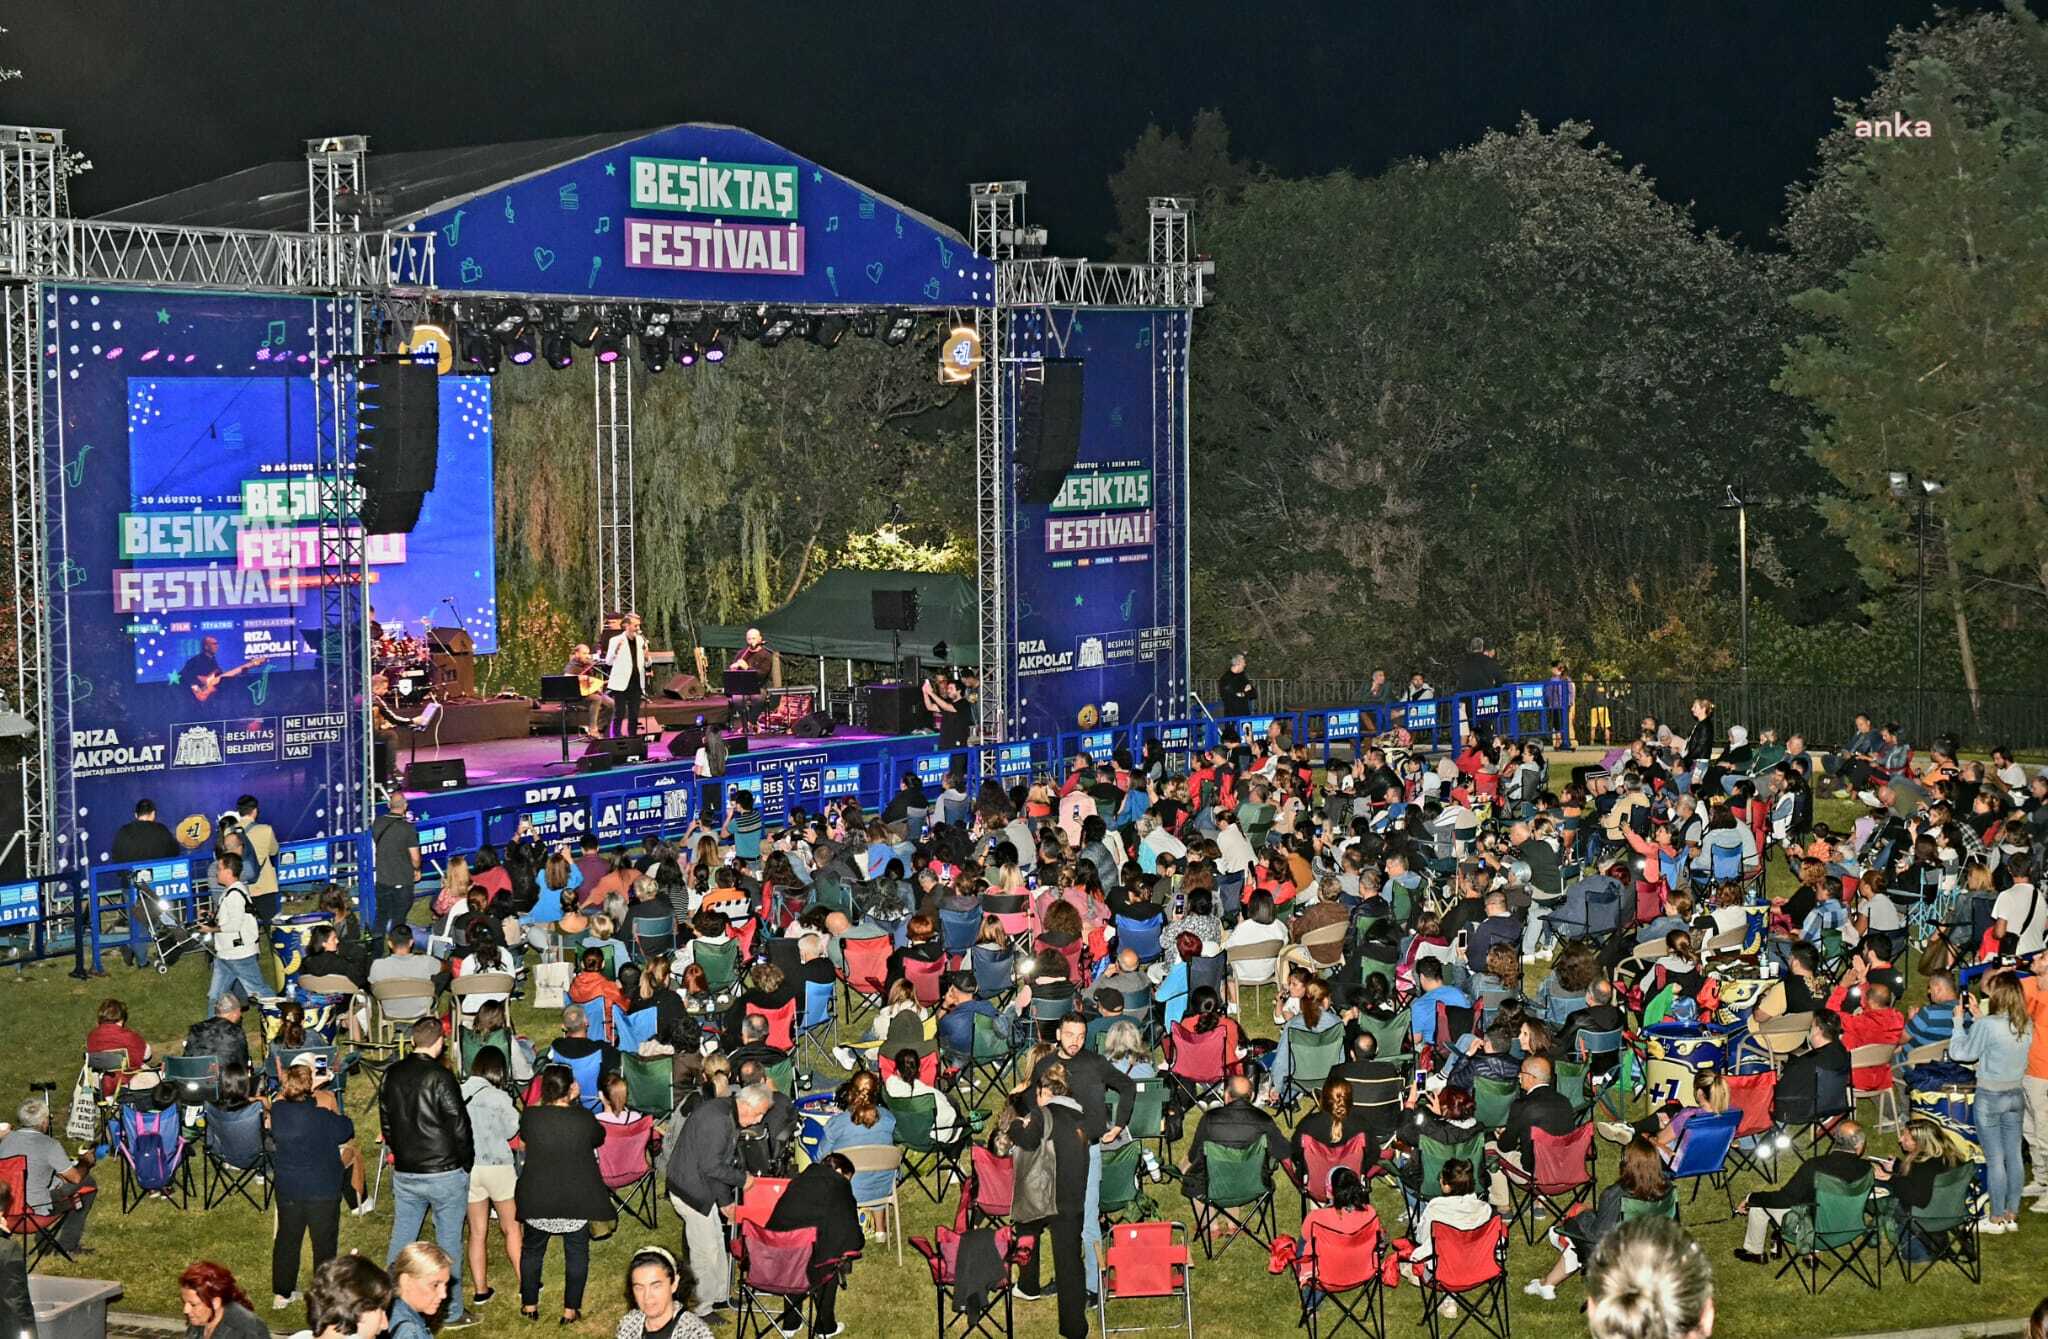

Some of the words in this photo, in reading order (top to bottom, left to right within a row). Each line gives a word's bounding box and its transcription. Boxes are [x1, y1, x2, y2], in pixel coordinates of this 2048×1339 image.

[634, 157, 794, 217] BEŞİKTAŞ
[631, 218, 798, 271] FESTİVALİ
[1049, 510, 1150, 550] FESTİVALİ
[1019, 639, 1046, 654] RIZA
[1019, 652, 1073, 669] AKPOLAT
[1476, 705, 1499, 716] ZABITA
[286, 718, 302, 728] NE
[307, 715, 345, 727] MUTLU
[1408, 716, 1436, 728] ZABITA
[73, 728, 119, 748] RIZA
[227, 729, 274, 742] BEŞİKTAŞ
[286, 730, 338, 743] BEŞİKTAŞ
[1328, 725, 1359, 737] ZABITA
[227, 741, 274, 755] BELEDİYESİ
[286, 745, 309, 757] VAR
[1162, 738, 1188, 750] ZABITA
[74, 745, 164, 769] AKPOLAT
[1001, 760, 1032, 773] ZABITA
[824, 783, 859, 794] ZABITA
[626, 808, 662, 822] ZABITA
[186, 822, 200, 838] +1
[278, 862, 328, 881] ZABITA
[1650, 1078, 1681, 1104] +1
